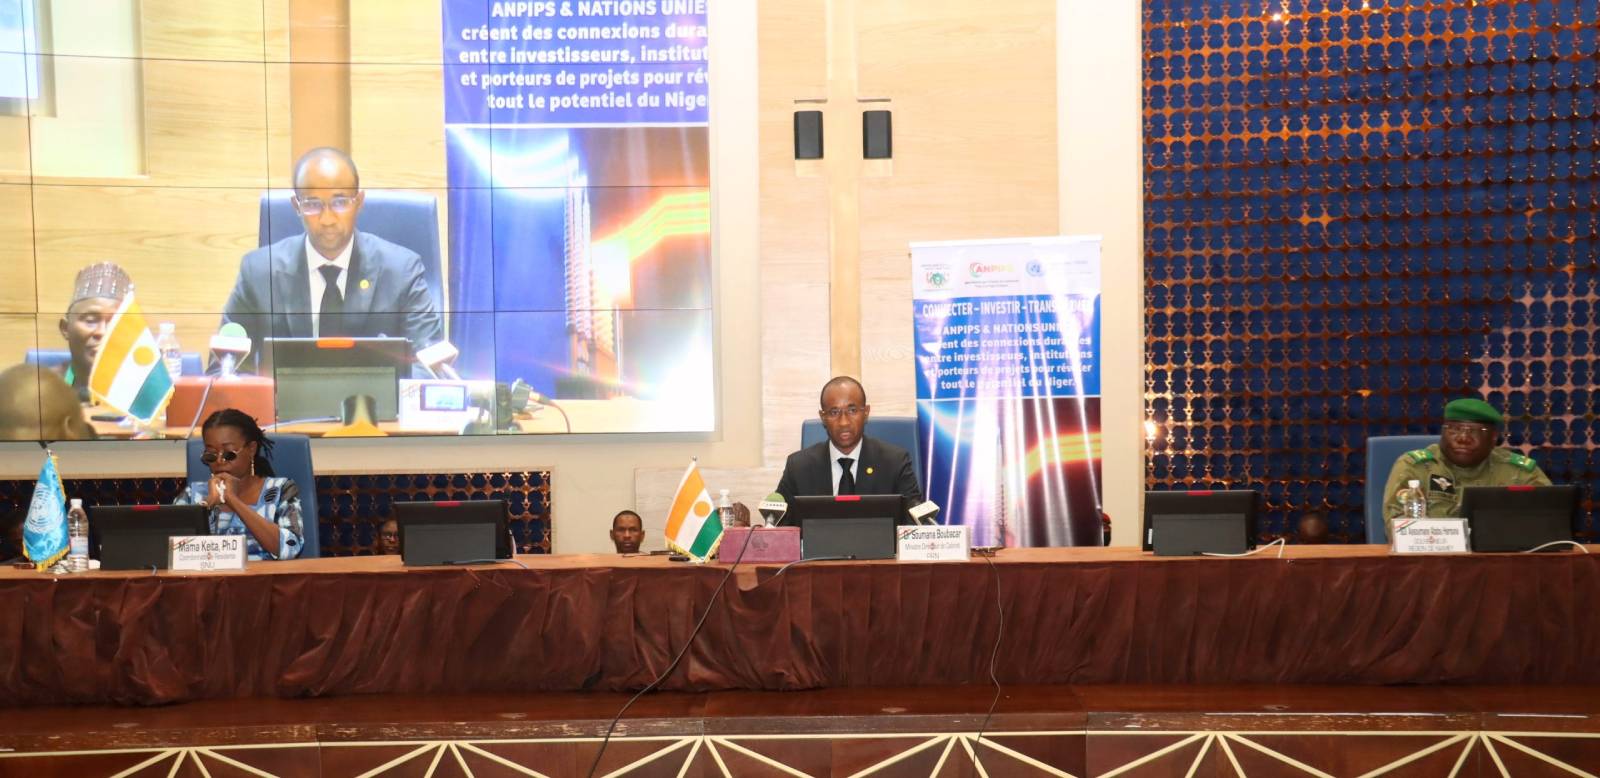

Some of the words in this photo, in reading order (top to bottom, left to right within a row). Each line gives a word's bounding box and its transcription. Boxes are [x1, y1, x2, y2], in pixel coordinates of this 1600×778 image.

[492, 2, 555, 17] ANPIPS
[559, 1, 574, 17] &
[578, 0, 656, 16] NATIONS
[661, 0, 708, 16] UNIE
[461, 24, 518, 41] créent
[522, 24, 552, 40] des
[557, 22, 661, 39] connexions
[459, 48, 506, 63] entre
[510, 45, 636, 64] investisseurs,
[460, 71, 478, 86] et
[481, 71, 551, 90] porteurs
[555, 70, 576, 85] de
[579, 68, 639, 89] projets
[643, 71, 683, 88] pour
[487, 94, 524, 109] tout
[528, 93, 545, 108] le
[549, 91, 632, 112] potentiel
[637, 92, 660, 107] du
[665, 91, 708, 111] Nige
[980, 300, 1020, 315] INVESTIR
[943, 324, 981, 336] ANPIPS
[982, 324, 992, 334] &
[993, 322, 1040, 333] NATIONS
[960, 338, 979, 349] des
[1044, 335, 1092, 347] duraes
[937, 365, 979, 379] porteurs
[941, 379, 962, 390] tout
